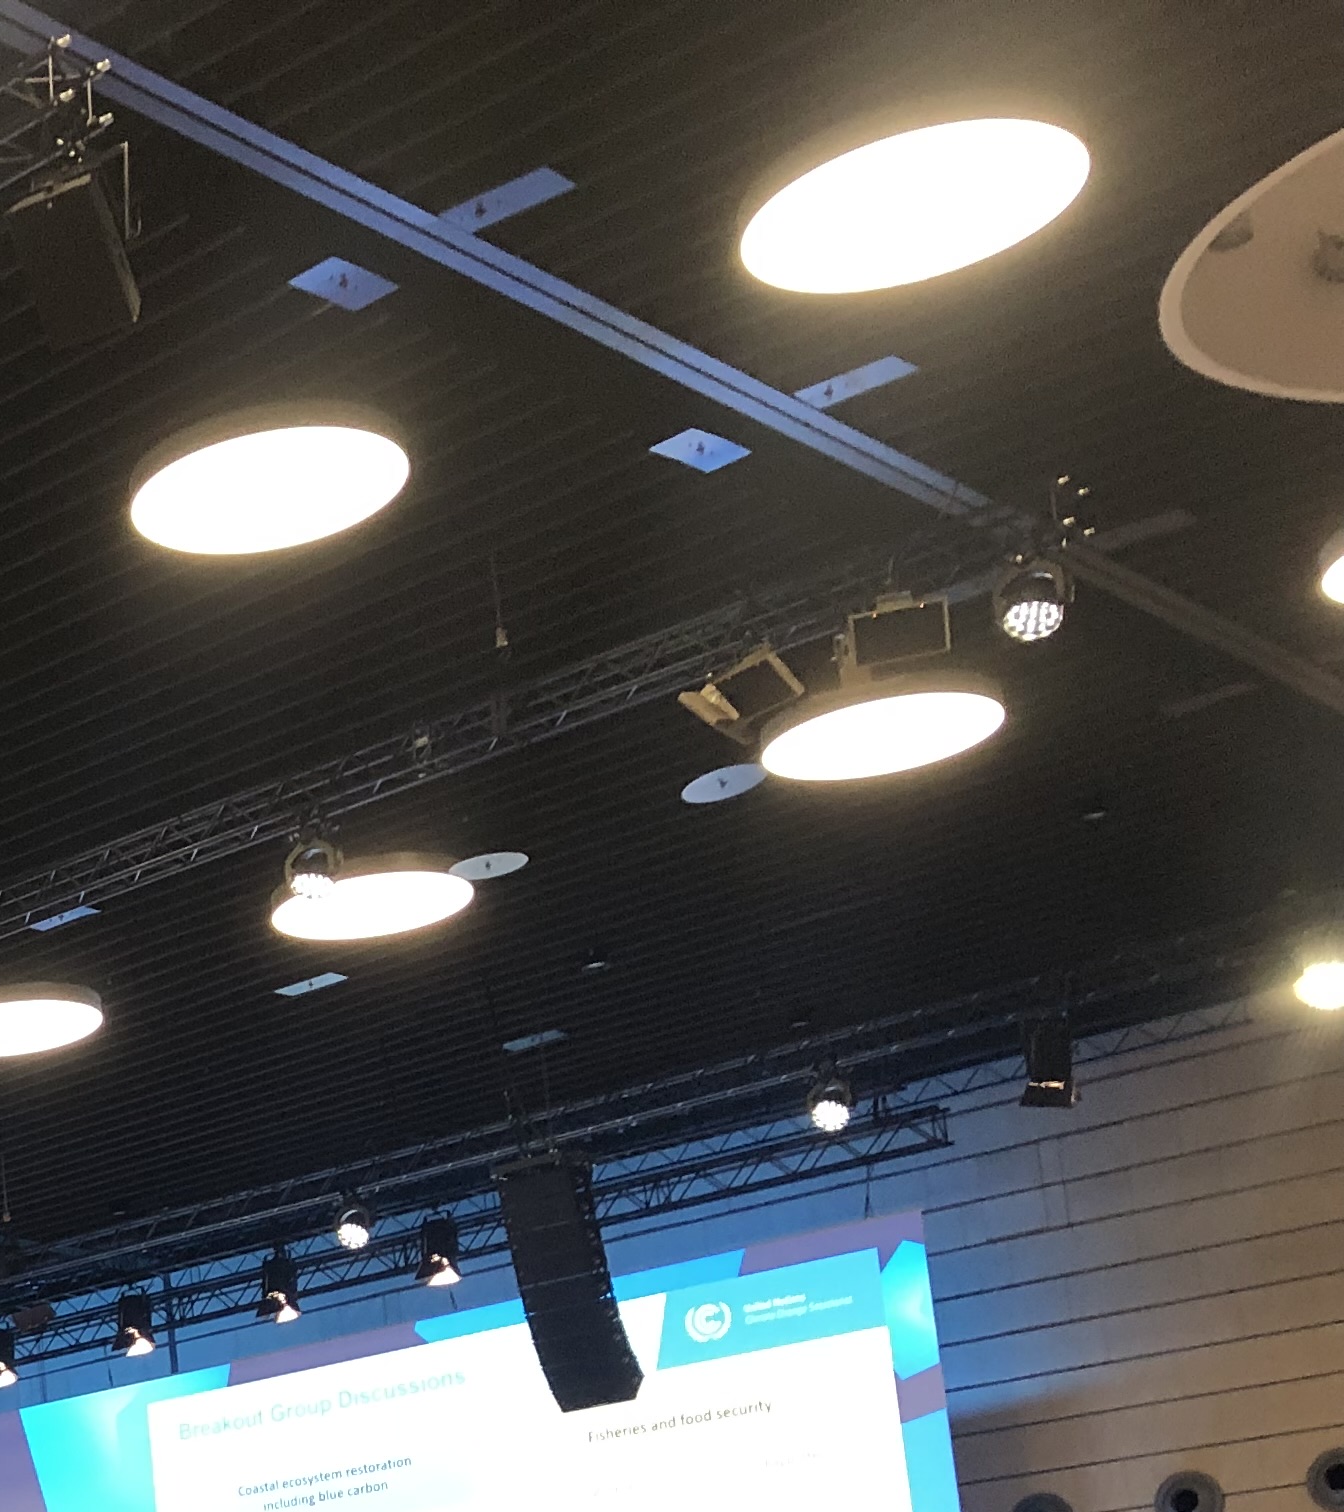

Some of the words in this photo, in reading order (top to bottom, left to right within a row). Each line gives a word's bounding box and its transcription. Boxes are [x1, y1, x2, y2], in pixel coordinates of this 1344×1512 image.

[179, 1410, 263, 1440] Breakout
[270, 1400, 331, 1423] Group
[338, 1369, 466, 1409] Discussions
[588, 1424, 647, 1443] Fisheries
[651, 1417, 676, 1432] and
[680, 1410, 712, 1426] food
[716, 1401, 772, 1420] security
[238, 1480, 279, 1497] Coastal
[282, 1469, 342, 1490] ecosystem
[345, 1456, 412, 1477] restoration
[263, 1492, 315, 1512] including
[318, 1488, 344, 1503] blue
[347, 1480, 389, 1497] carbon
